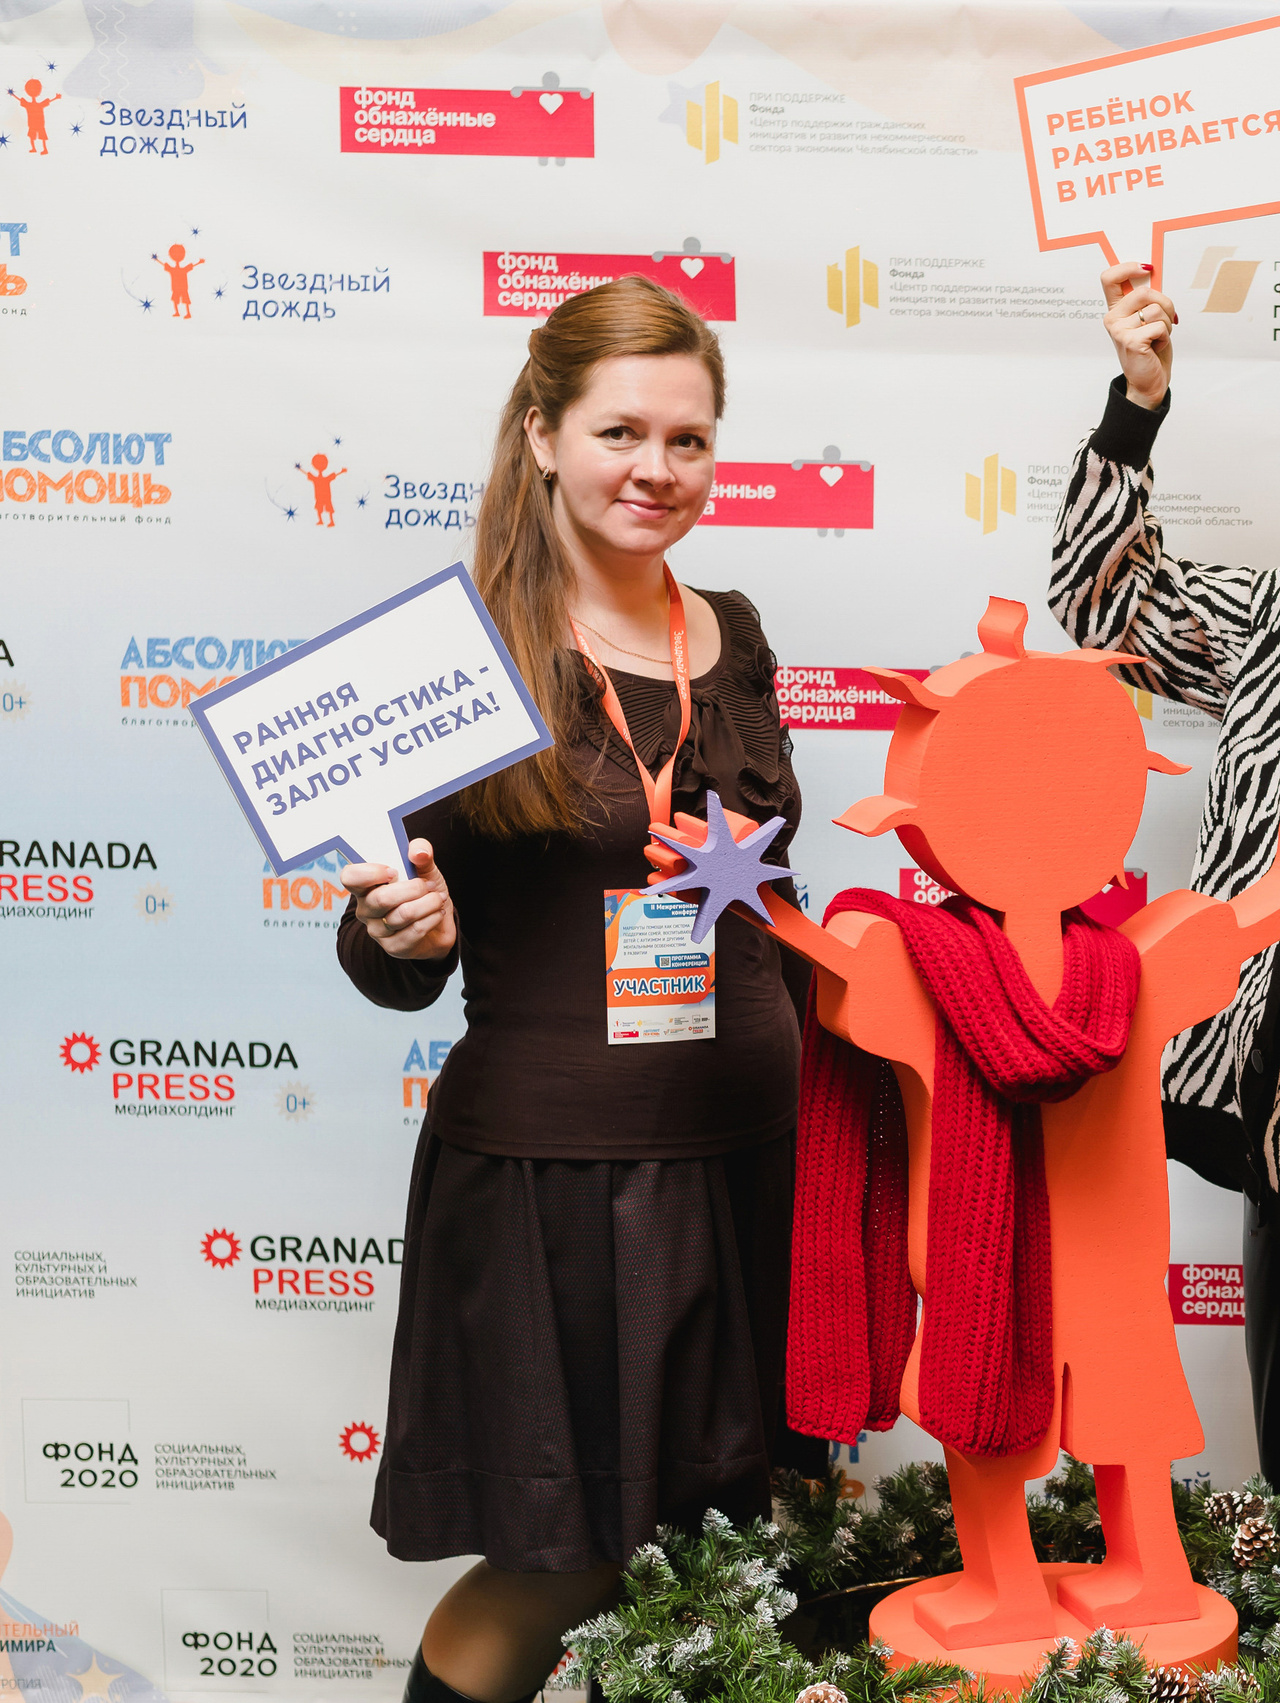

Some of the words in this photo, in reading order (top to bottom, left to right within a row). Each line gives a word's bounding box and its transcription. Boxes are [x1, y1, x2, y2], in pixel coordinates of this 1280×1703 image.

[354, 87, 415, 109] фонд
[100, 101, 248, 130] Звездный
[354, 106, 495, 128] обнажённые
[1047, 91, 1195, 136] РЕБЁНОК
[100, 134, 194, 158] дождь
[354, 127, 436, 147] сердца
[1057, 180, 1077, 203] В
[1084, 165, 1164, 198] ИГРЕ
[497, 252, 558, 272] фонд
[242, 266, 391, 295] Звездный
[242, 298, 336, 322] дождь
[1068, 310, 1107, 320] област
[0, 469, 172, 509] ОМОЩЬ
[135, 515, 172, 525] фонд
[776, 667, 836, 687] фонд
[233, 682, 359, 755] РАННЯЯ
[779, 704, 856, 723] сердца
[251, 669, 475, 790] ДИАГНОСТИКА
[266, 754, 362, 816] ЗАЛОГ
[370, 691, 501, 766] УСПЕХА!
[145, 895, 170, 914] 0+
[613, 975, 706, 996] УЧАСТНИК
[110, 1039, 298, 1070] GRANADA
[112, 1073, 236, 1101] PRESS
[114, 1104, 236, 1118] медиахолдинг
[286, 1094, 310, 1112] 0+
[14, 1251, 106, 1263] СОЦИАЛЬНЫХ,
[15, 1263, 95, 1274] КУЛЬТУРНЫХ
[1182, 1264, 1240, 1283] фонд
[15, 1276, 138, 1288] ОБРАЗОВАТЕЛЬНЫХ
[253, 1269, 375, 1296] PRESS
[15, 1288, 96, 1299] ИНИЦИАТИВ
[255, 1298, 375, 1313] медиахолдинг
[43, 1442, 138, 1465] ФОНД
[60, 1469, 138, 1488] 2020
[182, 1631, 277, 1655] ФОНД
[200, 1658, 278, 1678] 2020
